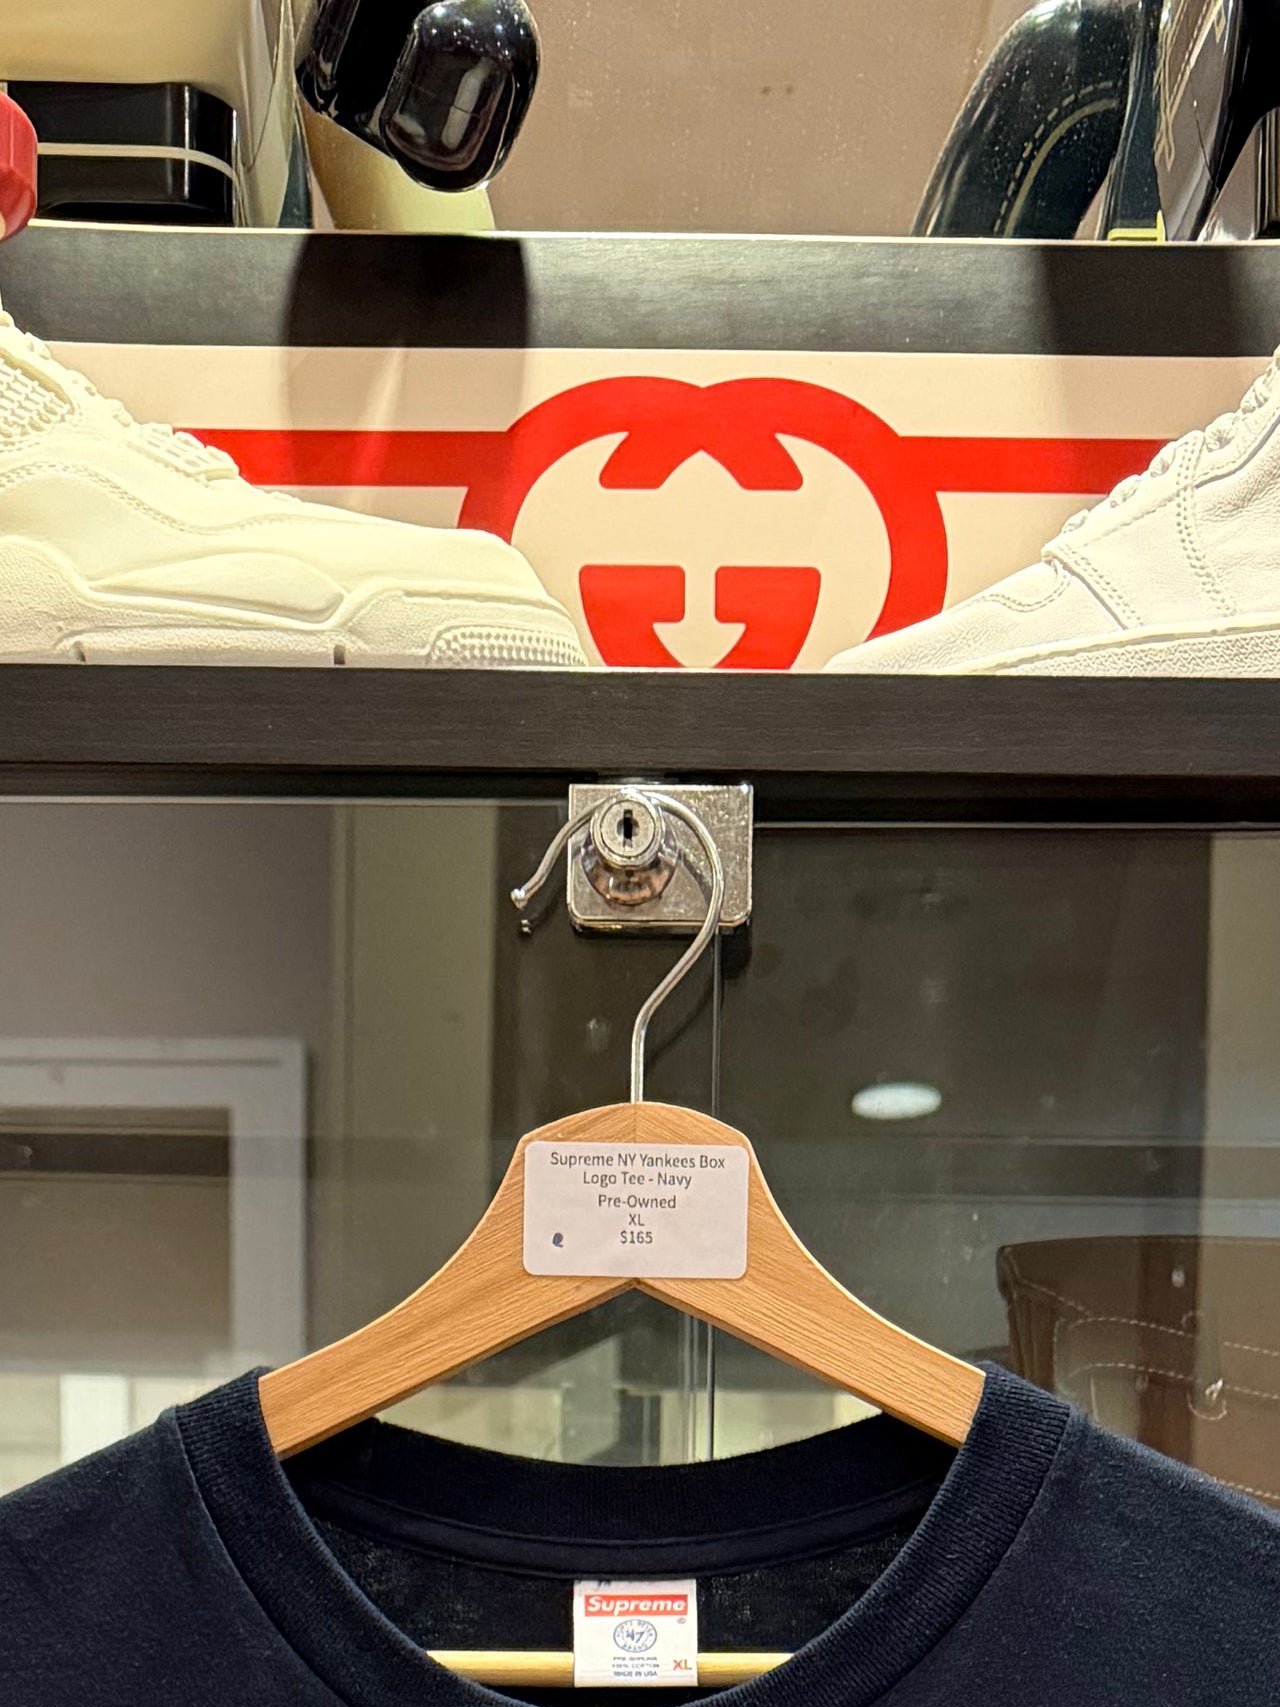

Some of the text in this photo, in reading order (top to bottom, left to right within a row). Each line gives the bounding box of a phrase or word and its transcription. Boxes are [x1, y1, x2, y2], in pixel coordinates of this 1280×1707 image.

[550, 1152, 725, 1169] Supreme NY Yankees Box
[583, 1172, 617, 1188] Logo
[622, 1171, 645, 1185] Tee
[657, 1172, 692, 1189] Navy
[598, 1194, 677, 1209] Pre-Owned
[628, 1213, 645, 1227] XL
[620, 1230, 653, 1244] $165
[587, 1596, 686, 1616] Supreme
[673, 1659, 692, 1671] XL
